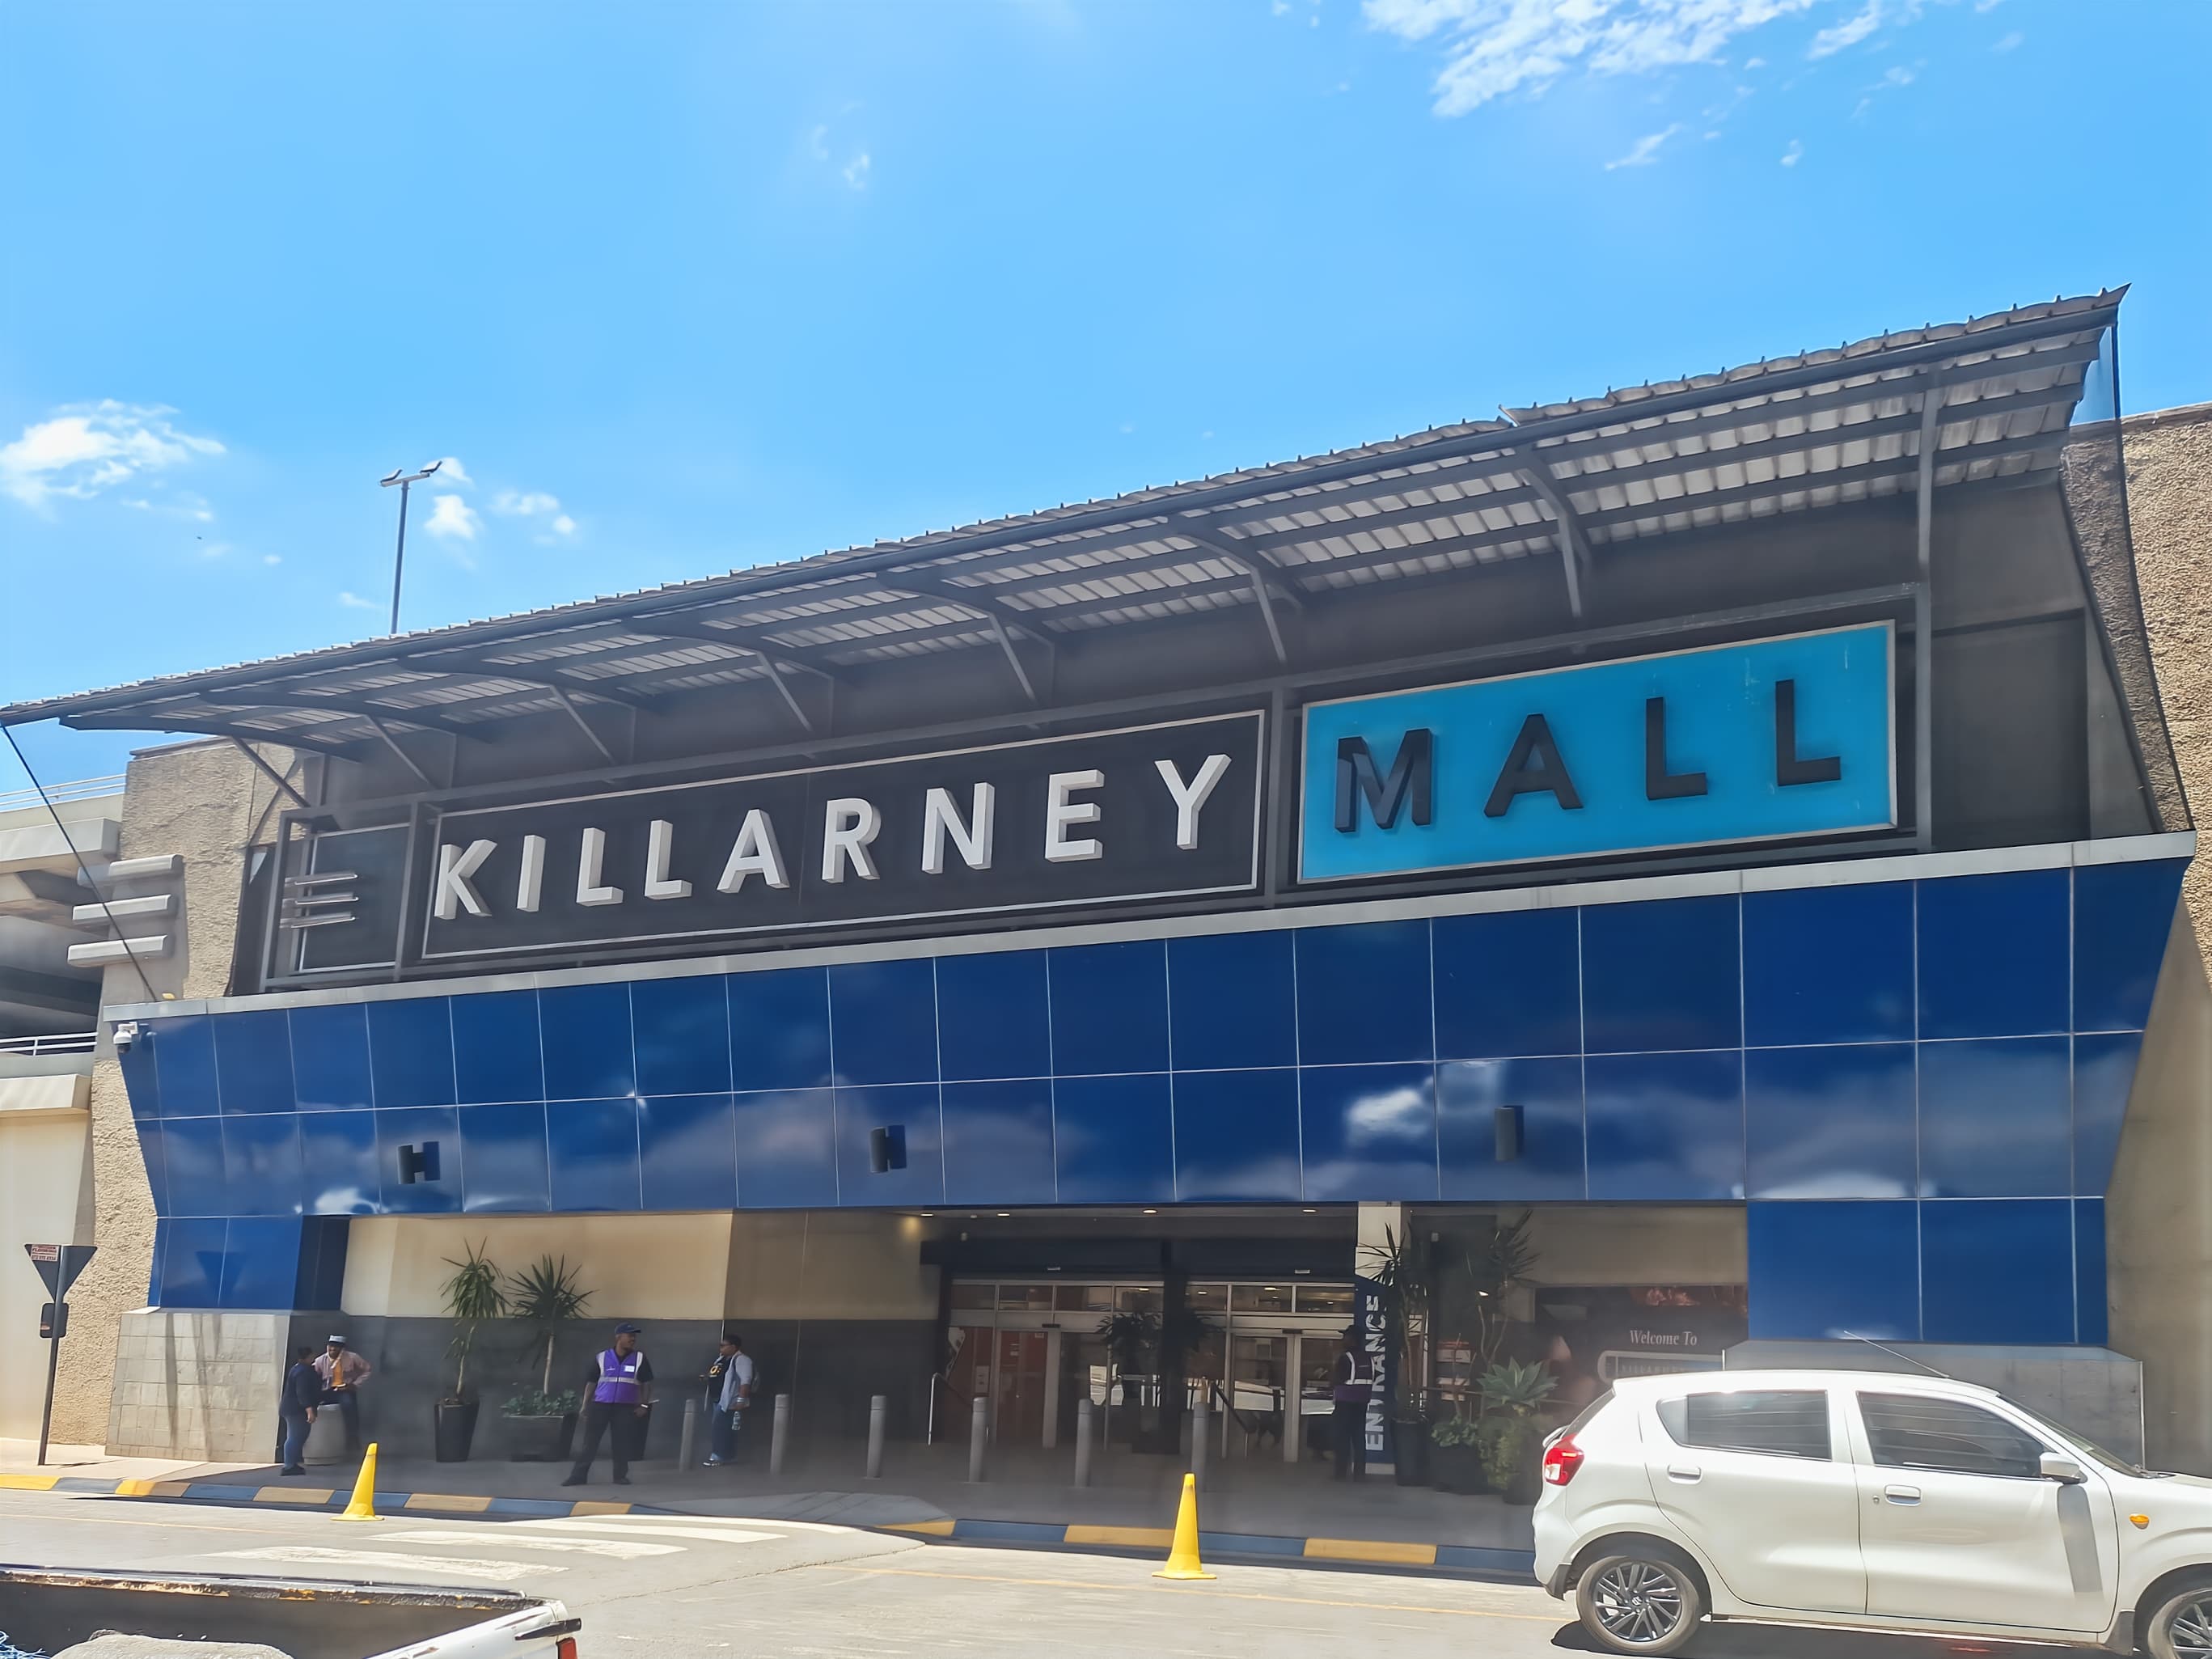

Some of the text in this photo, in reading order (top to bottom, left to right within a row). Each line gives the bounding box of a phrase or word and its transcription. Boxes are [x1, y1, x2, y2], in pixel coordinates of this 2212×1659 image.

[434, 679, 1842, 920] KILLARNEY MALL
[1630, 1330, 1697, 1346] Welcome To
